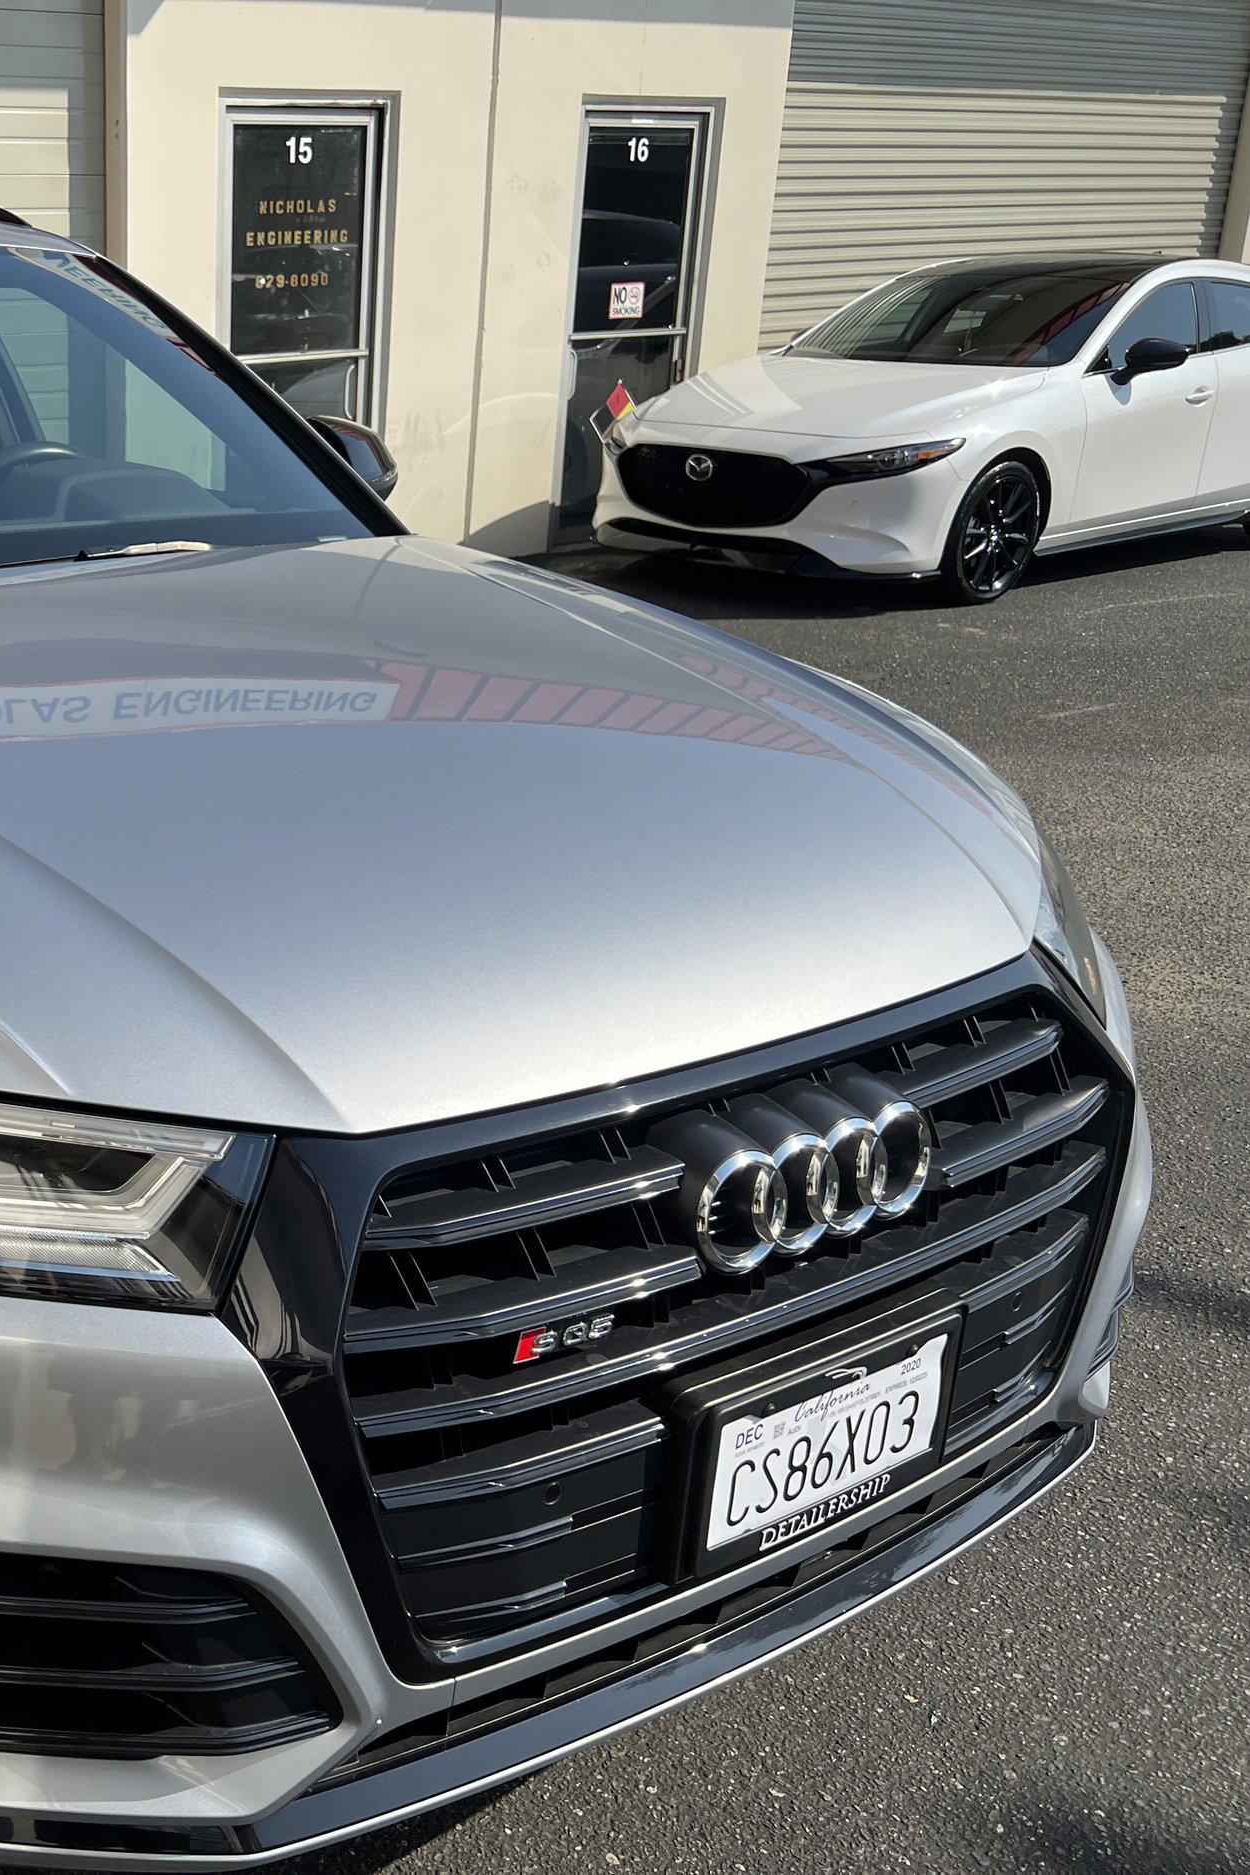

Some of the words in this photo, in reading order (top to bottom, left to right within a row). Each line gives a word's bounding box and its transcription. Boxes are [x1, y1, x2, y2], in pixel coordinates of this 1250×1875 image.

[286, 136, 313, 164] 15
[627, 137, 649, 162] 16
[259, 198, 337, 214] NICHOLAS
[246, 229, 348, 246] ENGINEERING
[613, 286, 627, 305] NO
[611, 306, 640, 316] SMOKING
[901, 1358, 921, 1375] 2020
[795, 1384, 871, 1422] California
[735, 1424, 764, 1449] DEC
[726, 1390, 920, 1527] CS86X03
[759, 1474, 891, 1551] DETAILERSHIP
